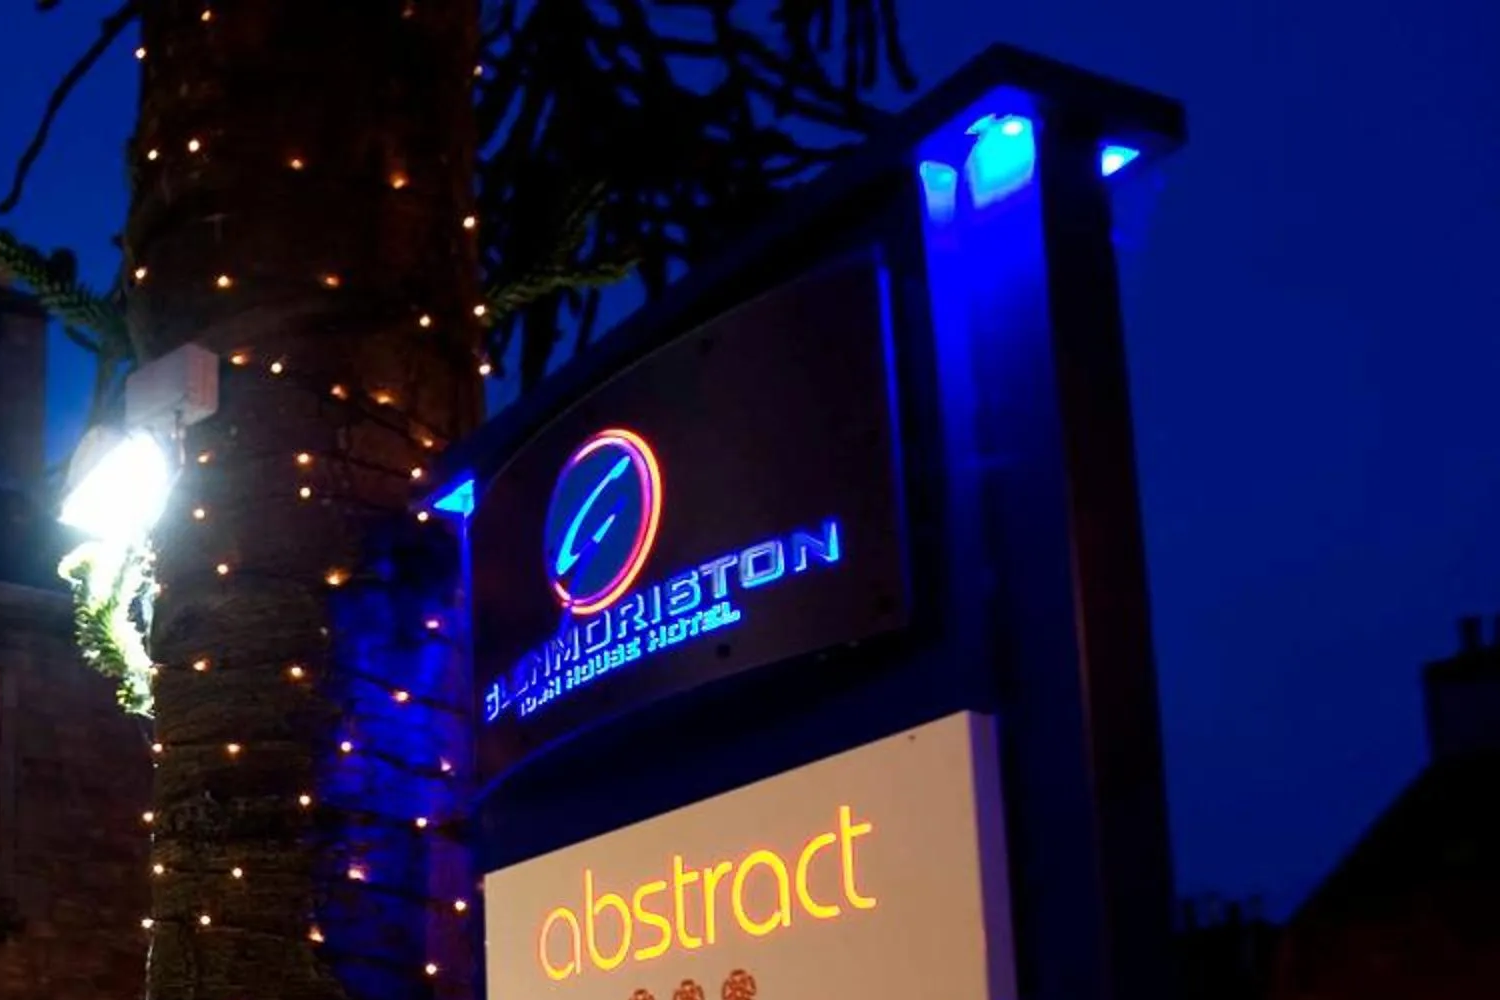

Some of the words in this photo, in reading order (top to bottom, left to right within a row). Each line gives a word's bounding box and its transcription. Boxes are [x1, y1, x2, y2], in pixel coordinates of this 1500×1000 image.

[565, 634, 643, 690] HOUSE
[646, 600, 742, 653] HOTEL
[538, 804, 878, 981] abstract
